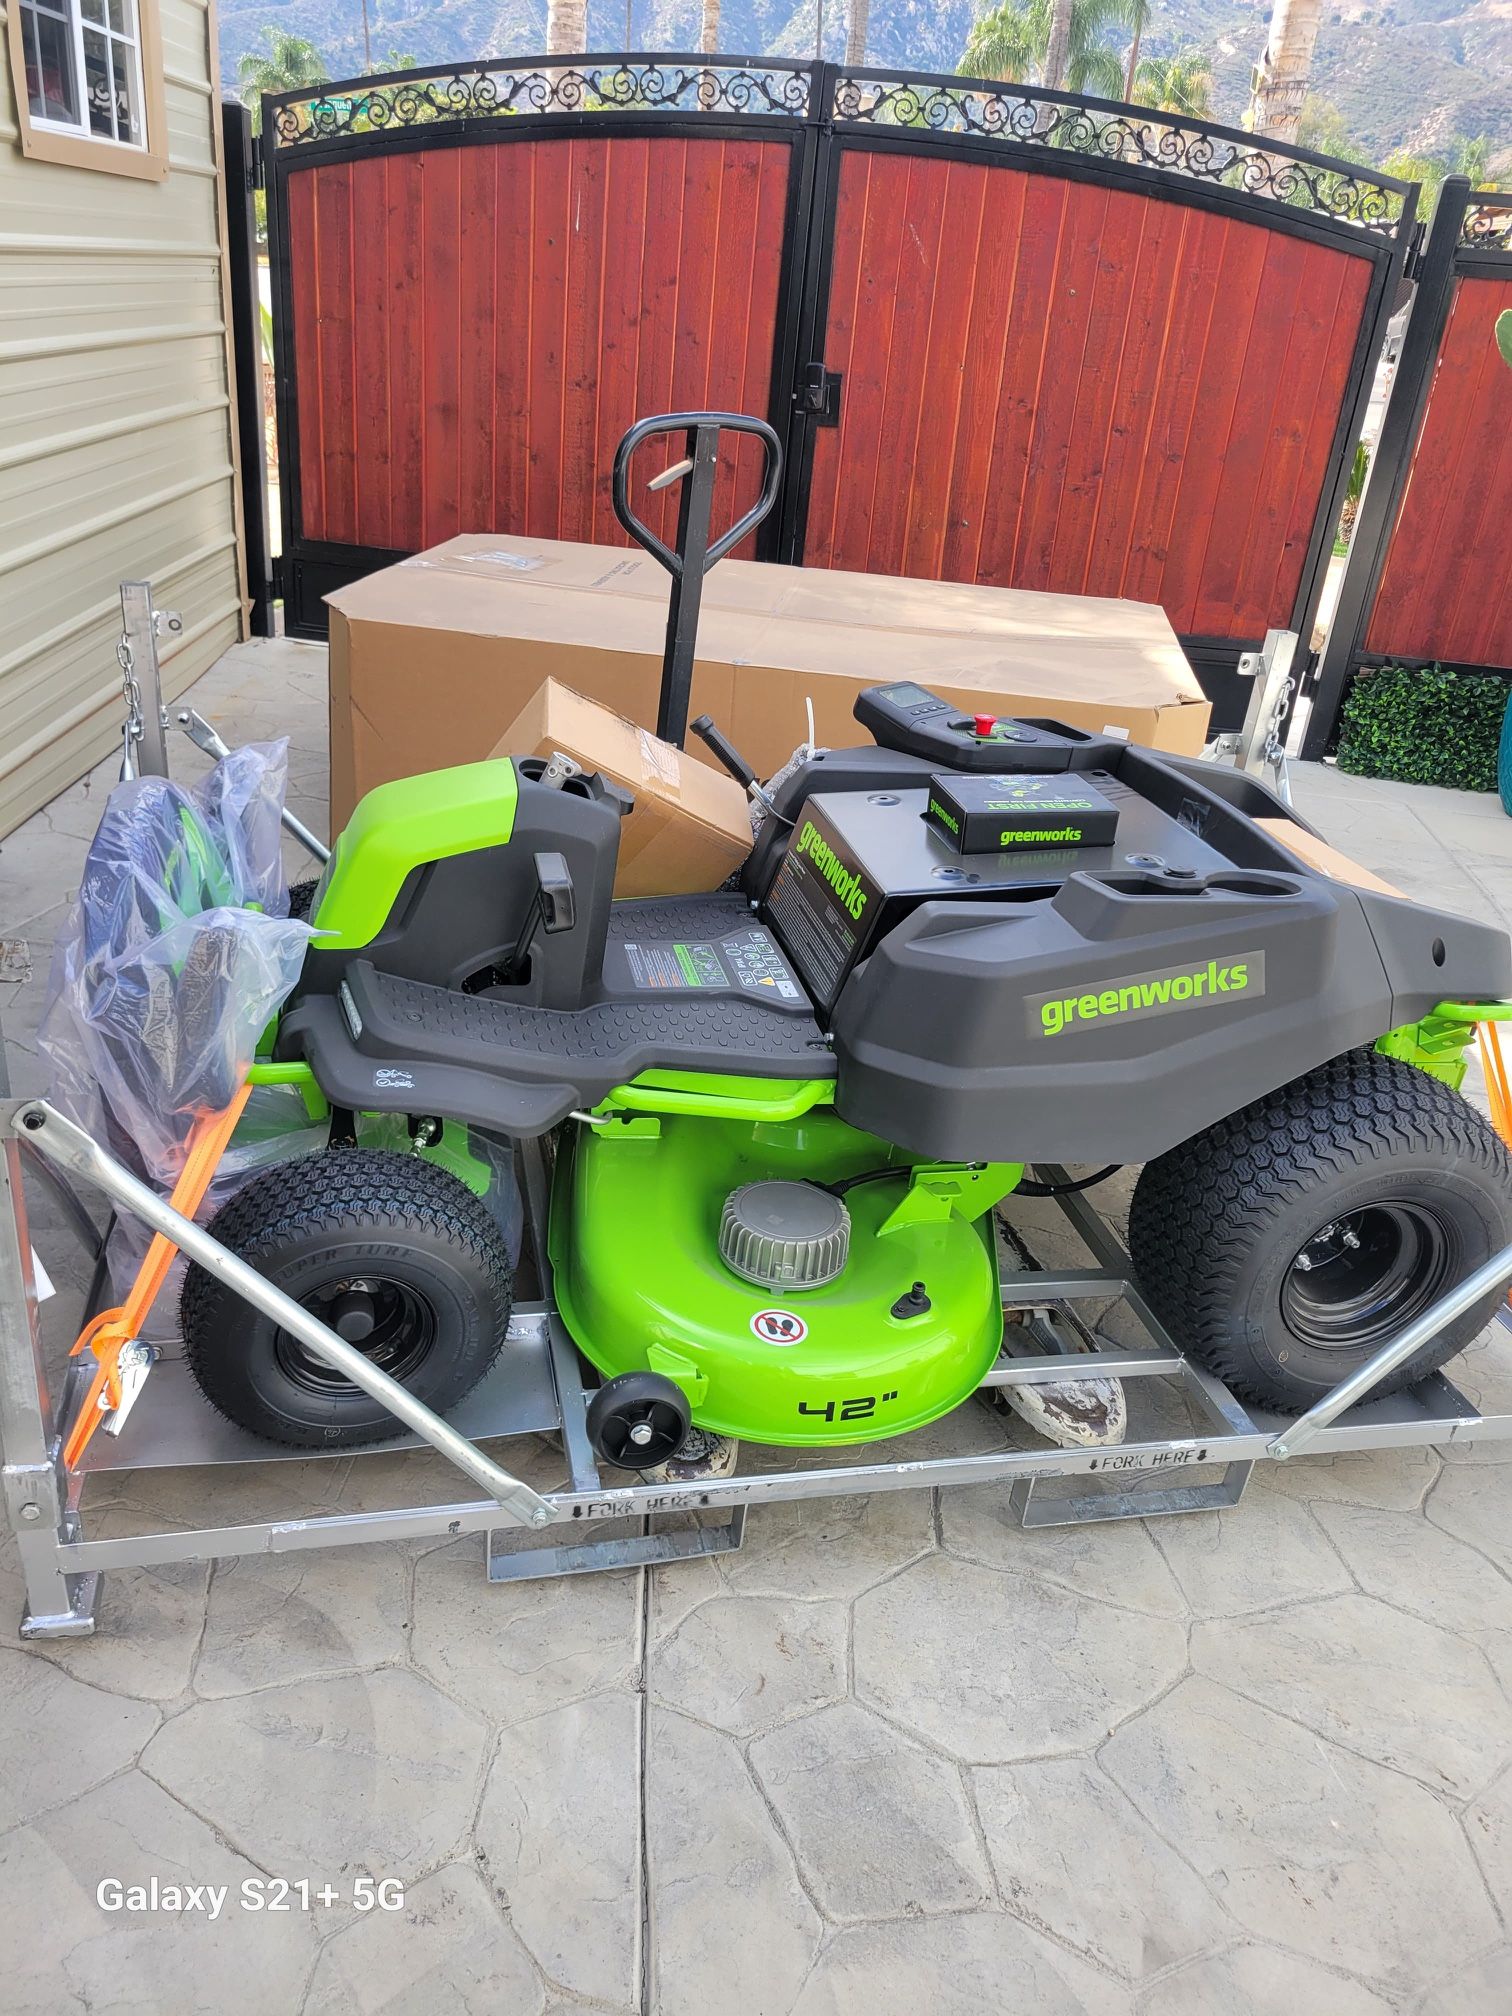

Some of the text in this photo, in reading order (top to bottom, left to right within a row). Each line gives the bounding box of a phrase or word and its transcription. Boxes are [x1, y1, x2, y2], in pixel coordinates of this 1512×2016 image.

[930, 799, 959, 834] greenworks
[1001, 827, 1082, 846] greenworks
[796, 821, 867, 920] greenworks
[1041, 961, 1248, 1036] greenworks
[798, 1390, 898, 1422] 42"
[1102, 1450, 1195, 1470] FORK HERE
